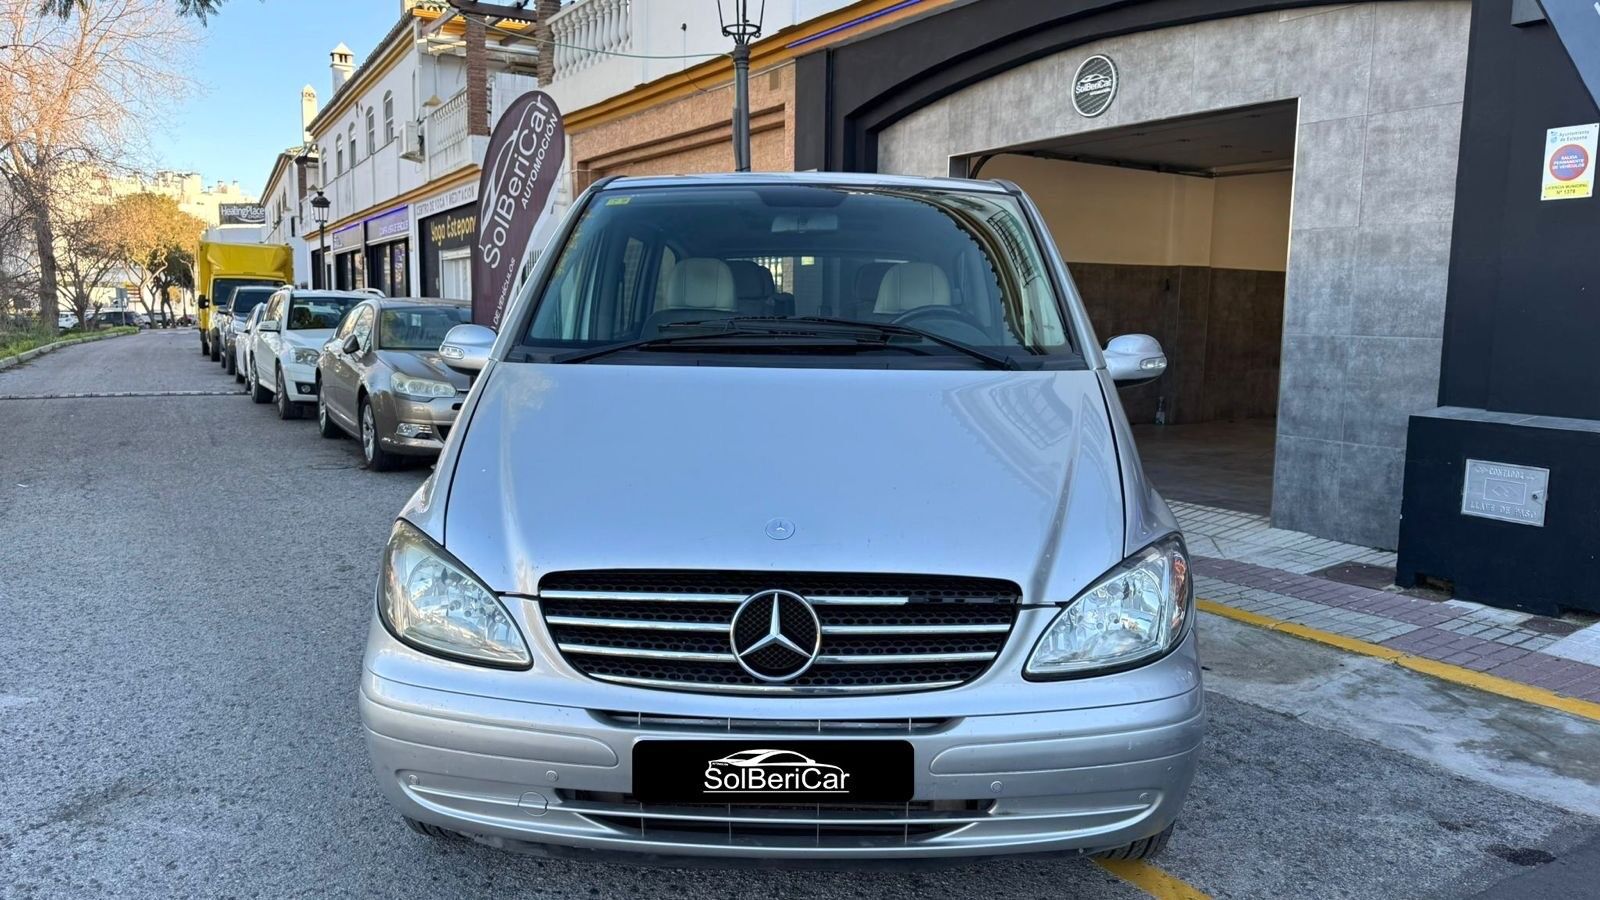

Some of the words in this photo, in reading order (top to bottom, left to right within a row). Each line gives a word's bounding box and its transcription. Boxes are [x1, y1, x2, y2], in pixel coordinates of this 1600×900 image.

[1076, 80, 1111, 94] SolBeriCar
[483, 95, 549, 269] SolBeriCar
[521, 112, 559, 210] AUTOMOCIÓN
[430, 221, 446, 247] Yoga
[446, 215, 477, 241] Estepon
